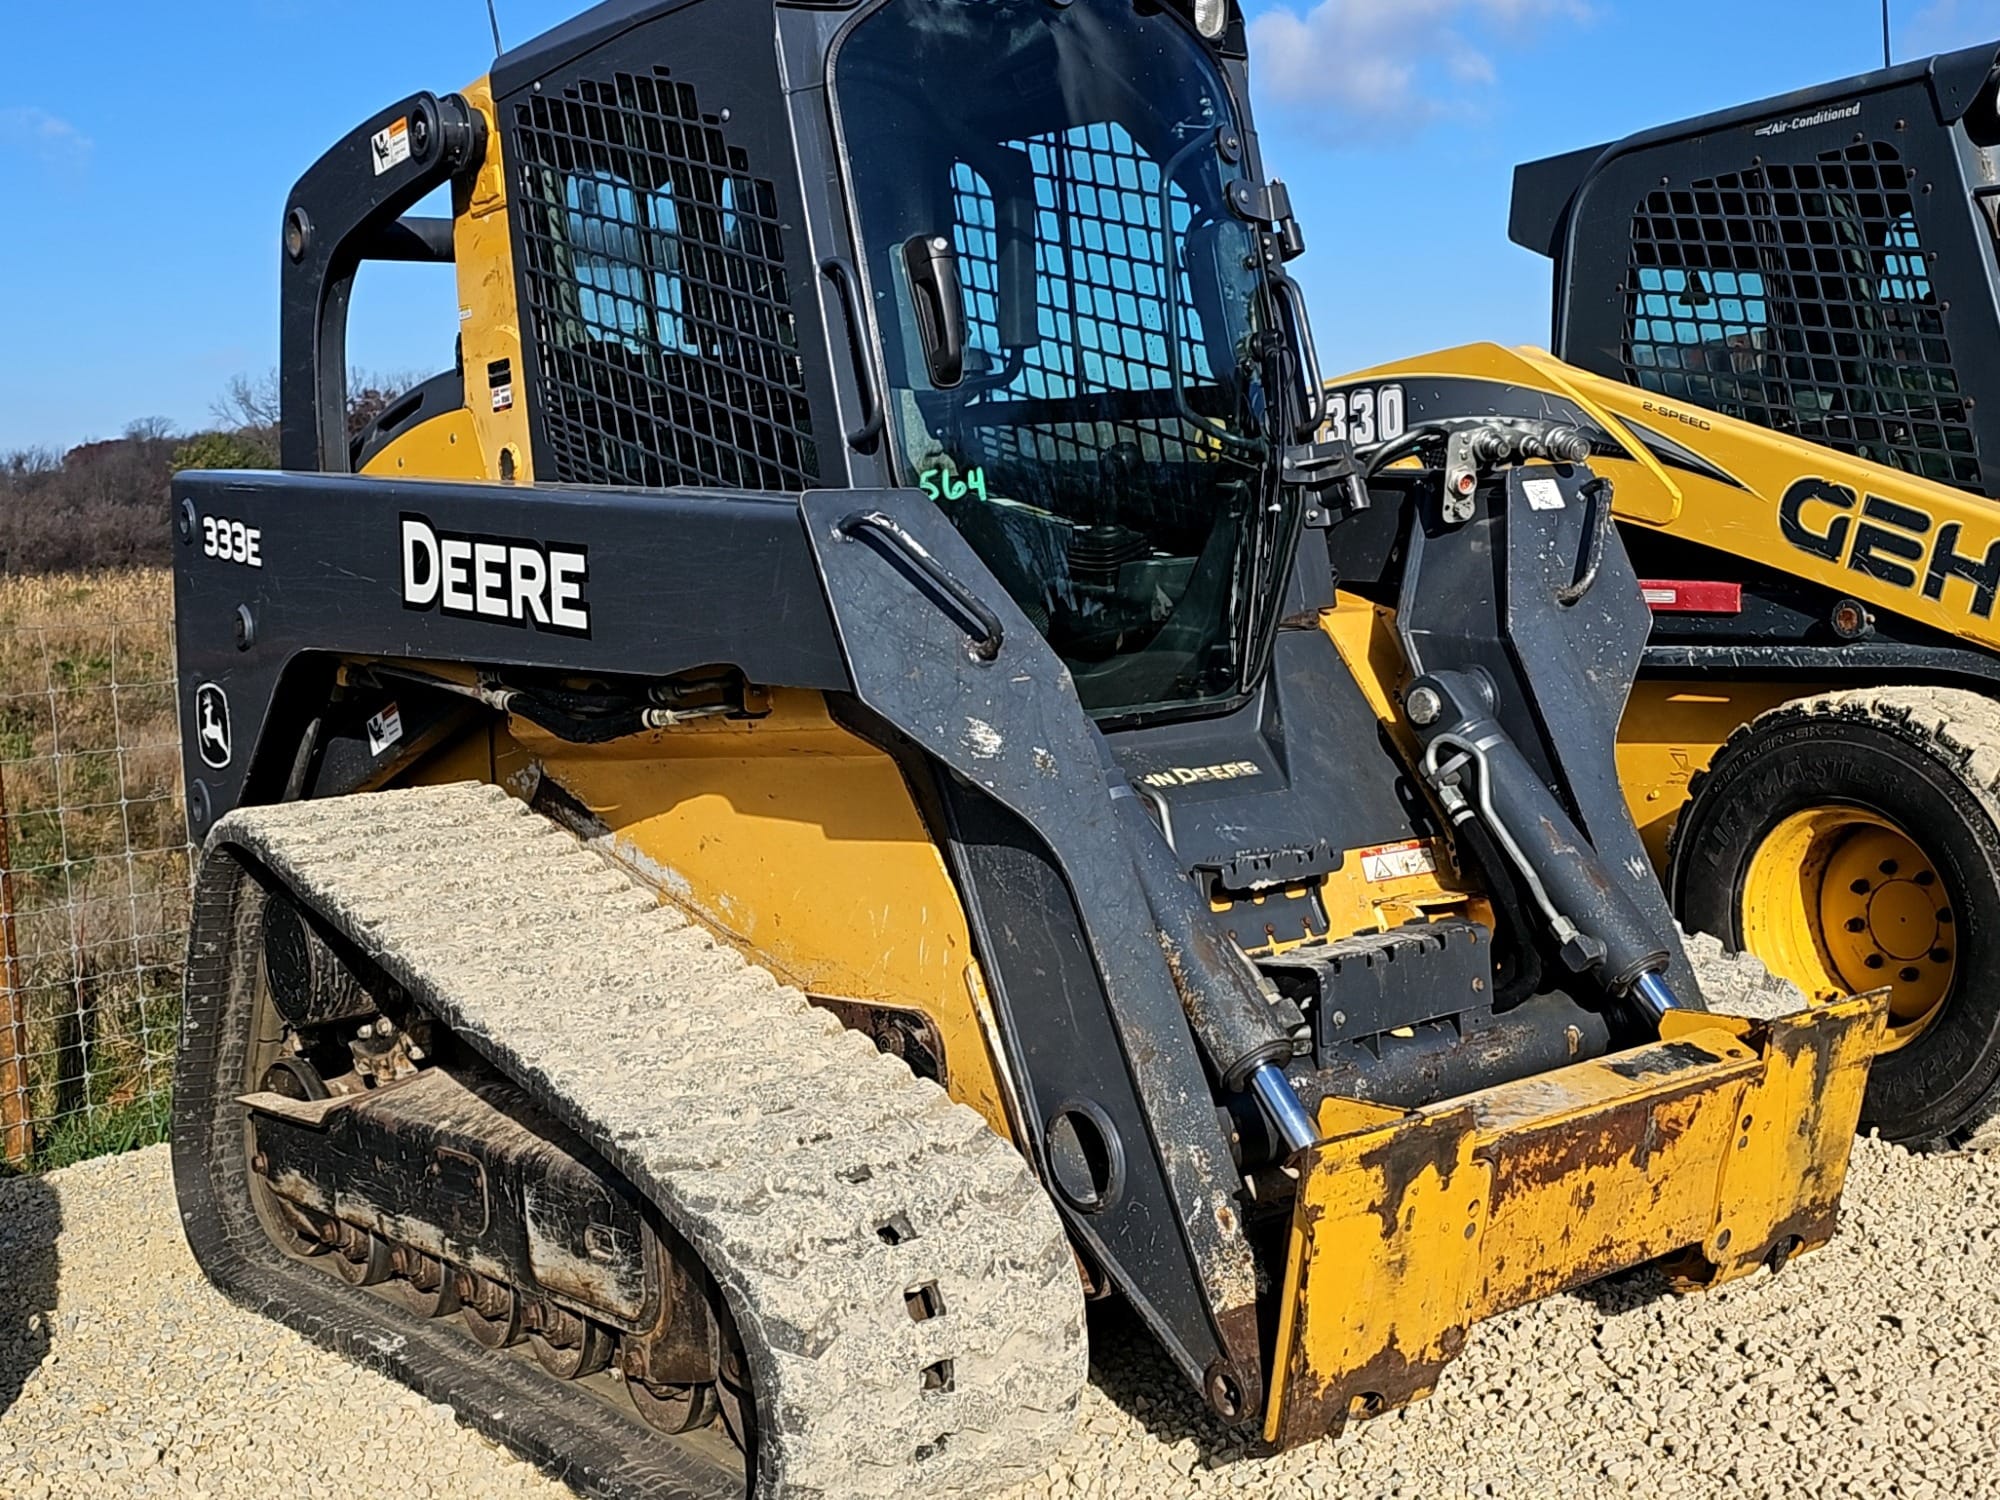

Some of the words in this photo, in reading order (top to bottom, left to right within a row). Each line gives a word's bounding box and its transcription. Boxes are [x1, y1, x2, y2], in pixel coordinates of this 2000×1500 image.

[1771, 101, 1861, 135] Air-Conditioned
[1309, 384, 1404, 445] 330
[920, 466, 987, 501] 564
[203, 516, 262, 567] 333E
[402, 520, 588, 630] DEERE
